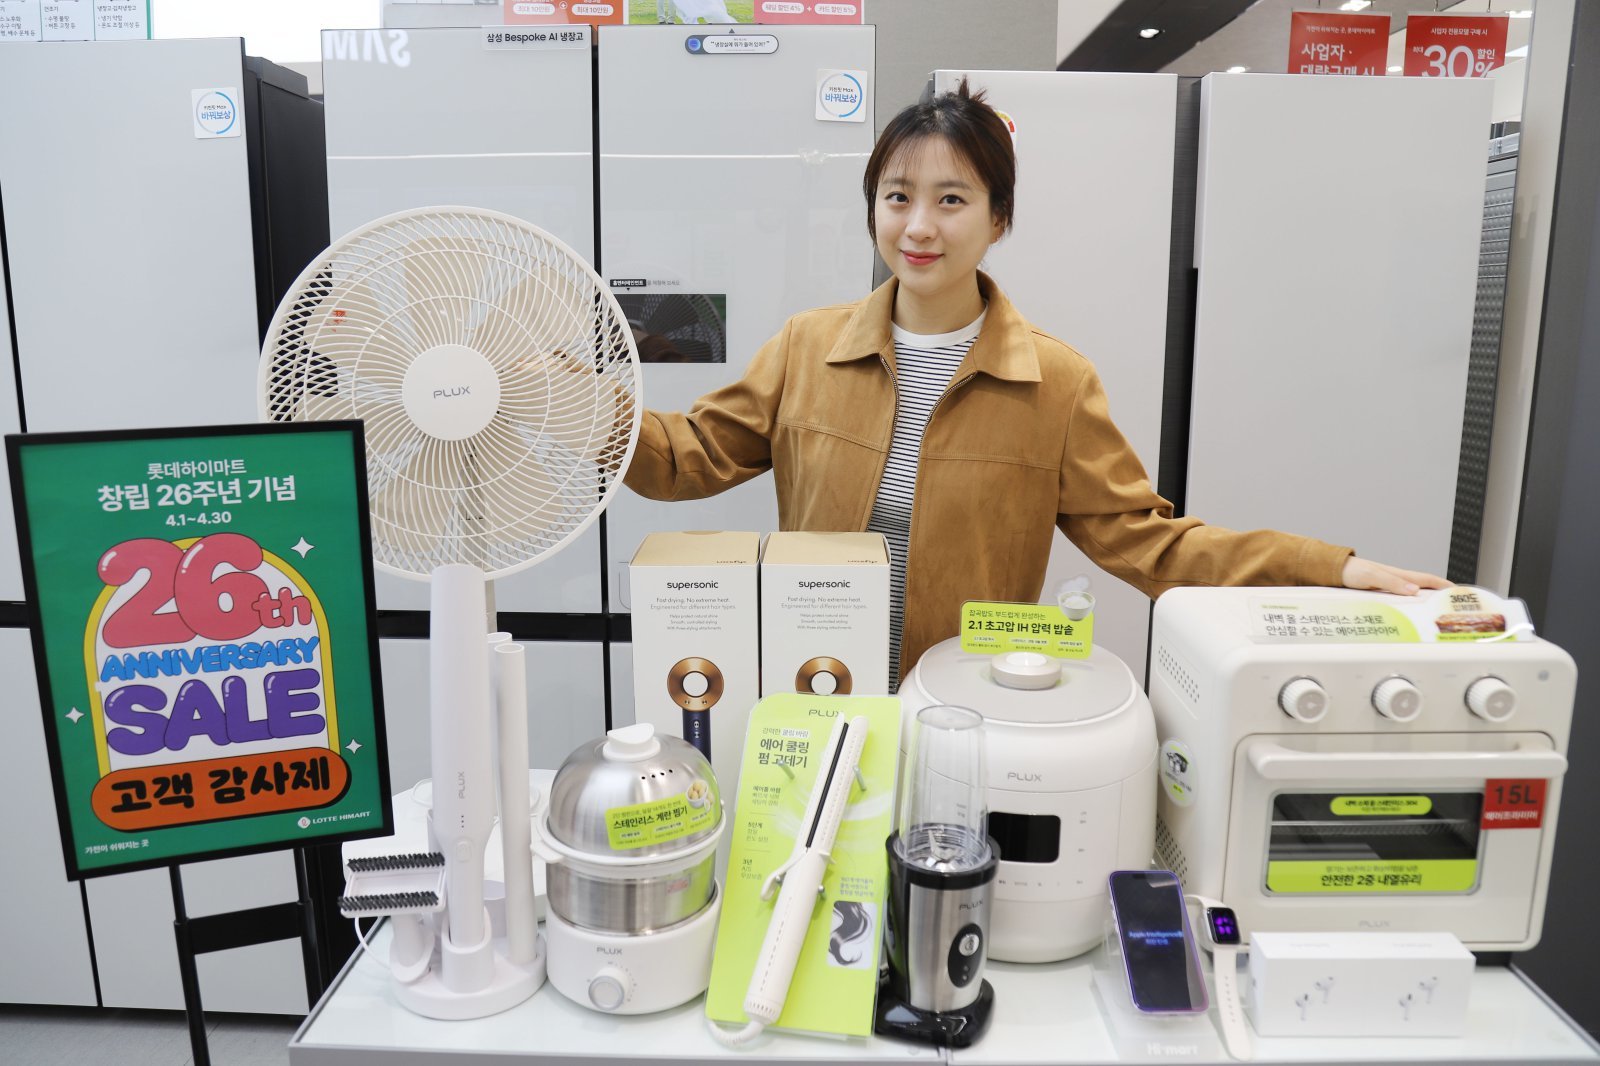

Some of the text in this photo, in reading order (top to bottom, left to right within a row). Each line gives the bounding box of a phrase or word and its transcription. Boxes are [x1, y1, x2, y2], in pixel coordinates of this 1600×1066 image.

[487, 32, 584, 44] 삼성 Bespoke AI 냉장고
[1301, 43, 1345, 62] 사업자
[1477, 48, 1496, 60] 할인
[825, 94, 858, 104] 바꿔보상
[201, 111, 231, 120] 바꿔보상
[433, 386, 470, 399] PLUX
[147, 459, 247, 480] 롯데하이마트
[97, 474, 296, 512] 창립 26주년 기념
[166, 511, 232, 527] 4.1~4.30
[97, 532, 313, 649] 26th
[666, 580, 718, 590] supersonic
[798, 580, 851, 590] supersonic
[1264, 614, 1284, 624] 내벽
[1300, 615, 1351, 625] 스테인리스
[1354, 615, 1384, 624] 소재로
[968, 620, 1074, 636] 2.1 초고압 IH 압력 밥솥
[1266, 626, 1400, 636] 안심할 수 있는 에어프라이어
[100, 636, 320, 683] ANNIVERSARY
[104, 668, 326, 756] SALE
[760, 738, 809, 754] 에어 쿨링
[758, 752, 808, 768] 펌 고데기
[111, 755, 331, 813] 고객 감사제
[1007, 772, 1042, 782] PLUX
[1495, 784, 1538, 804] 15L
[312, 811, 370, 824] LOTTE HIMART
[614, 816, 655, 830] 스테인리스
[656, 810, 672, 822] 계란
[673, 806, 688, 818] 찜기
[1322, 874, 1354, 886] 안전한
[1378, 874, 1422, 886] 내열유리
[596, 946, 622, 955] PLUX
